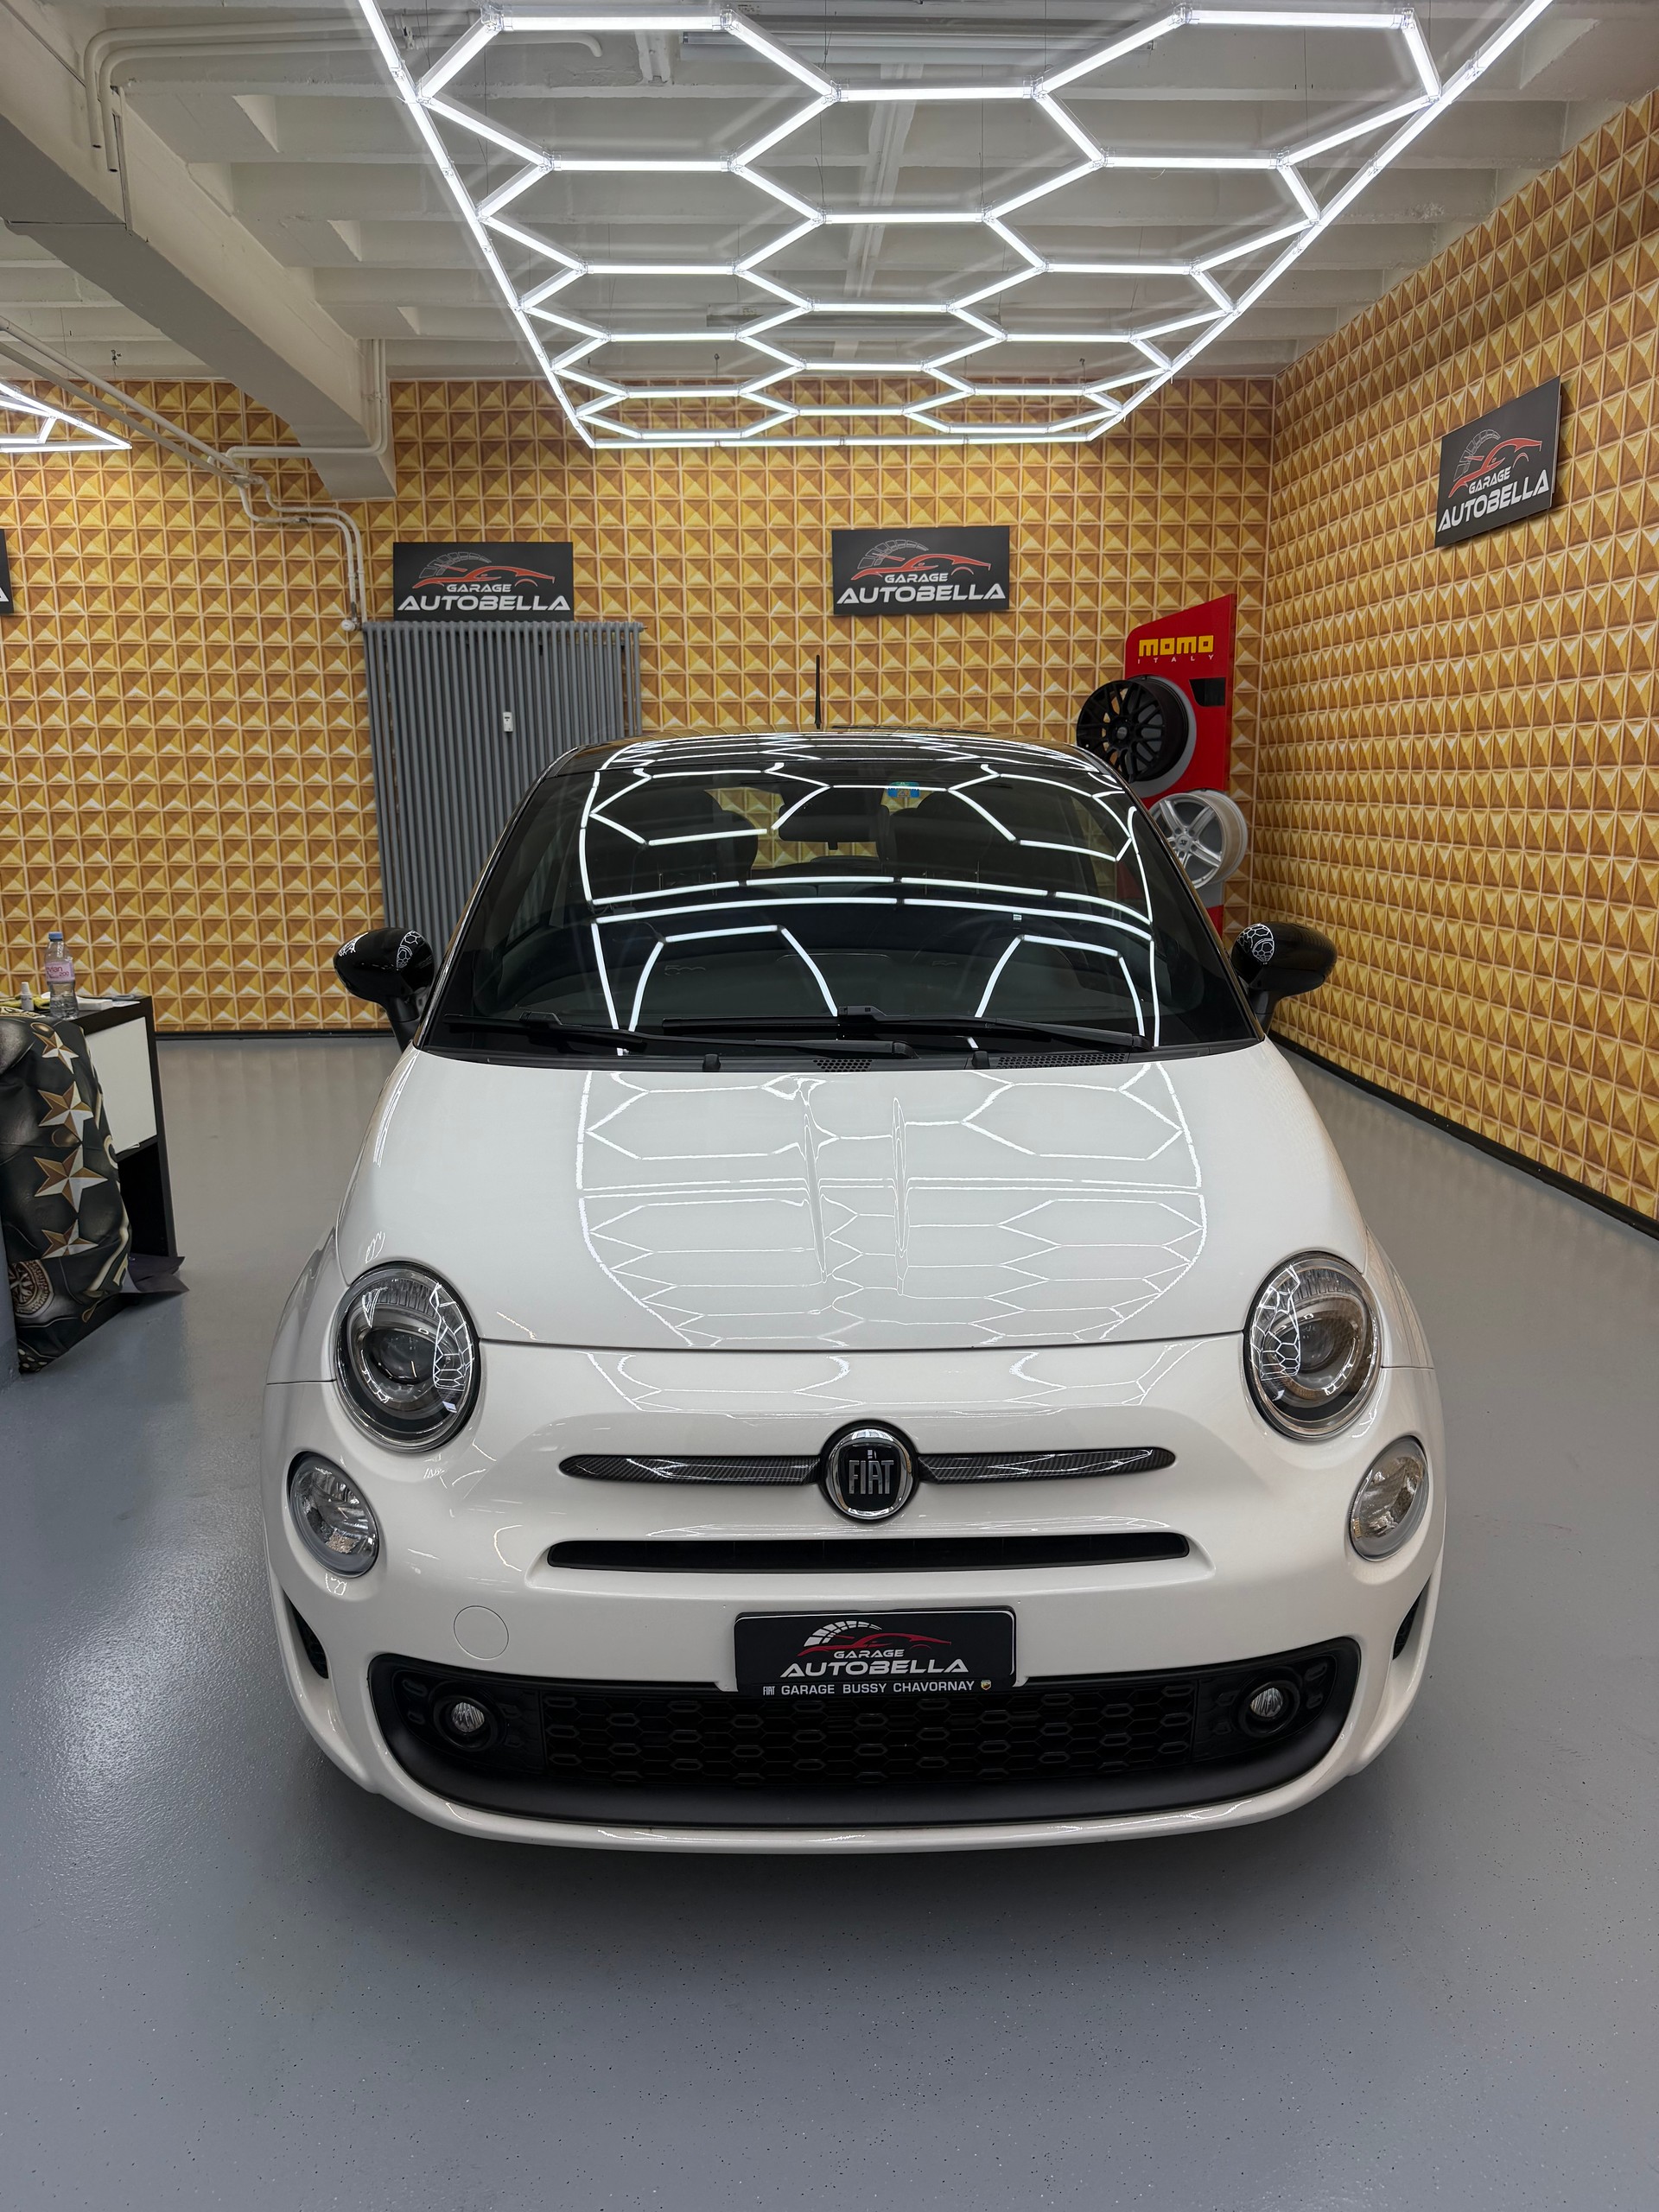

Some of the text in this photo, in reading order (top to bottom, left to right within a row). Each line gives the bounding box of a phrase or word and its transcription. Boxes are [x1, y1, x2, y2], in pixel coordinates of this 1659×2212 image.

[1469, 467, 1511, 494] GARAGE
[1437, 469, 1549, 532] AUTOBELLA
[884, 572, 949, 583] GARAGE
[446, 583, 512, 593] GARAGE
[836, 583, 1006, 604] AUTOBELLA
[397, 595, 571, 611] AUTOBELLA
[1137, 654, 1214, 664] ITALY
[849, 1459, 894, 1495] FIAT
[834, 1649, 905, 1659] GARAGE
[780, 1658, 969, 1678] AUTOBELLA
[762, 1681, 975, 1696] FIAT GARAGE BUSSY CHAVORNAY
